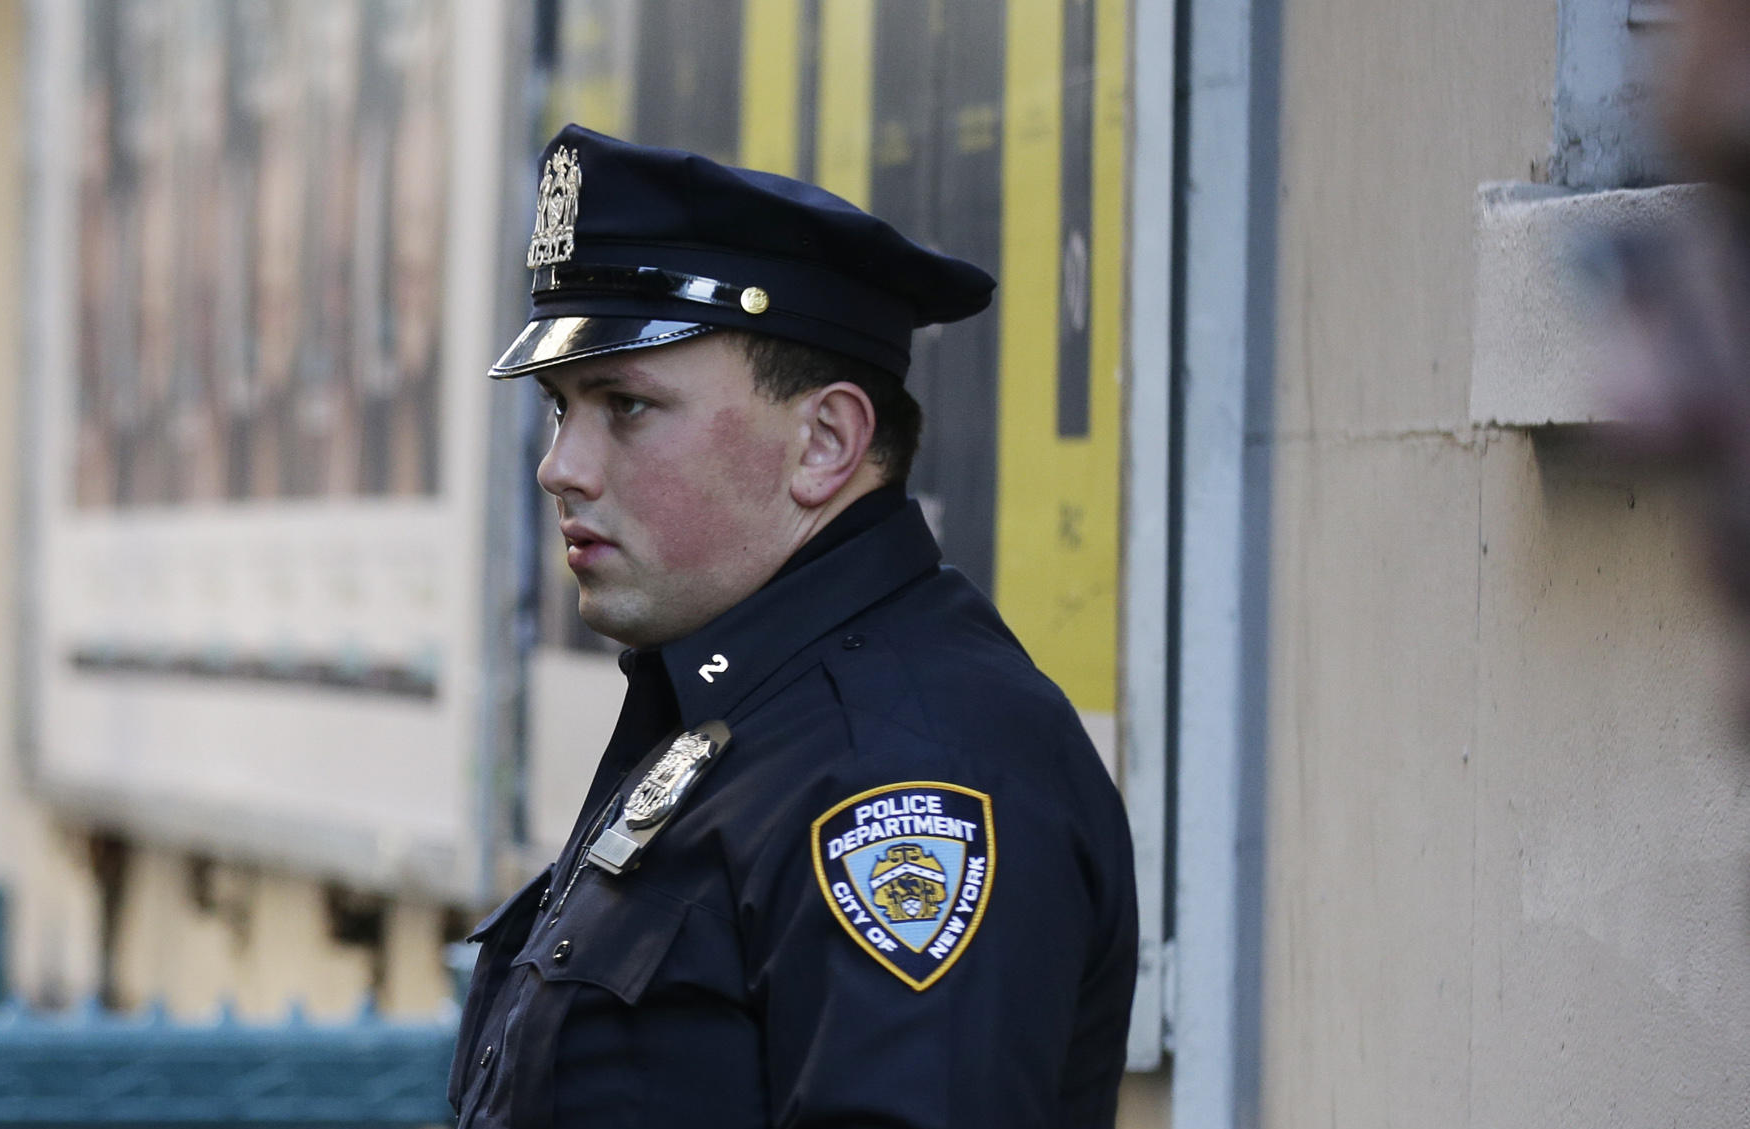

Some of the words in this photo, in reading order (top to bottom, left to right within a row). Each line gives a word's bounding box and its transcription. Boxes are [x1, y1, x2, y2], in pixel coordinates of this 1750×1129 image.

[698, 653, 729, 683] 2
[855, 794, 943, 827] POLICE
[827, 815, 978, 861] DEPARTMENT
[831, 881, 872, 926] CITY
[865, 926, 899, 953] OF
[927, 915, 967, 960] NEW
[954, 855, 987, 914] YORK
